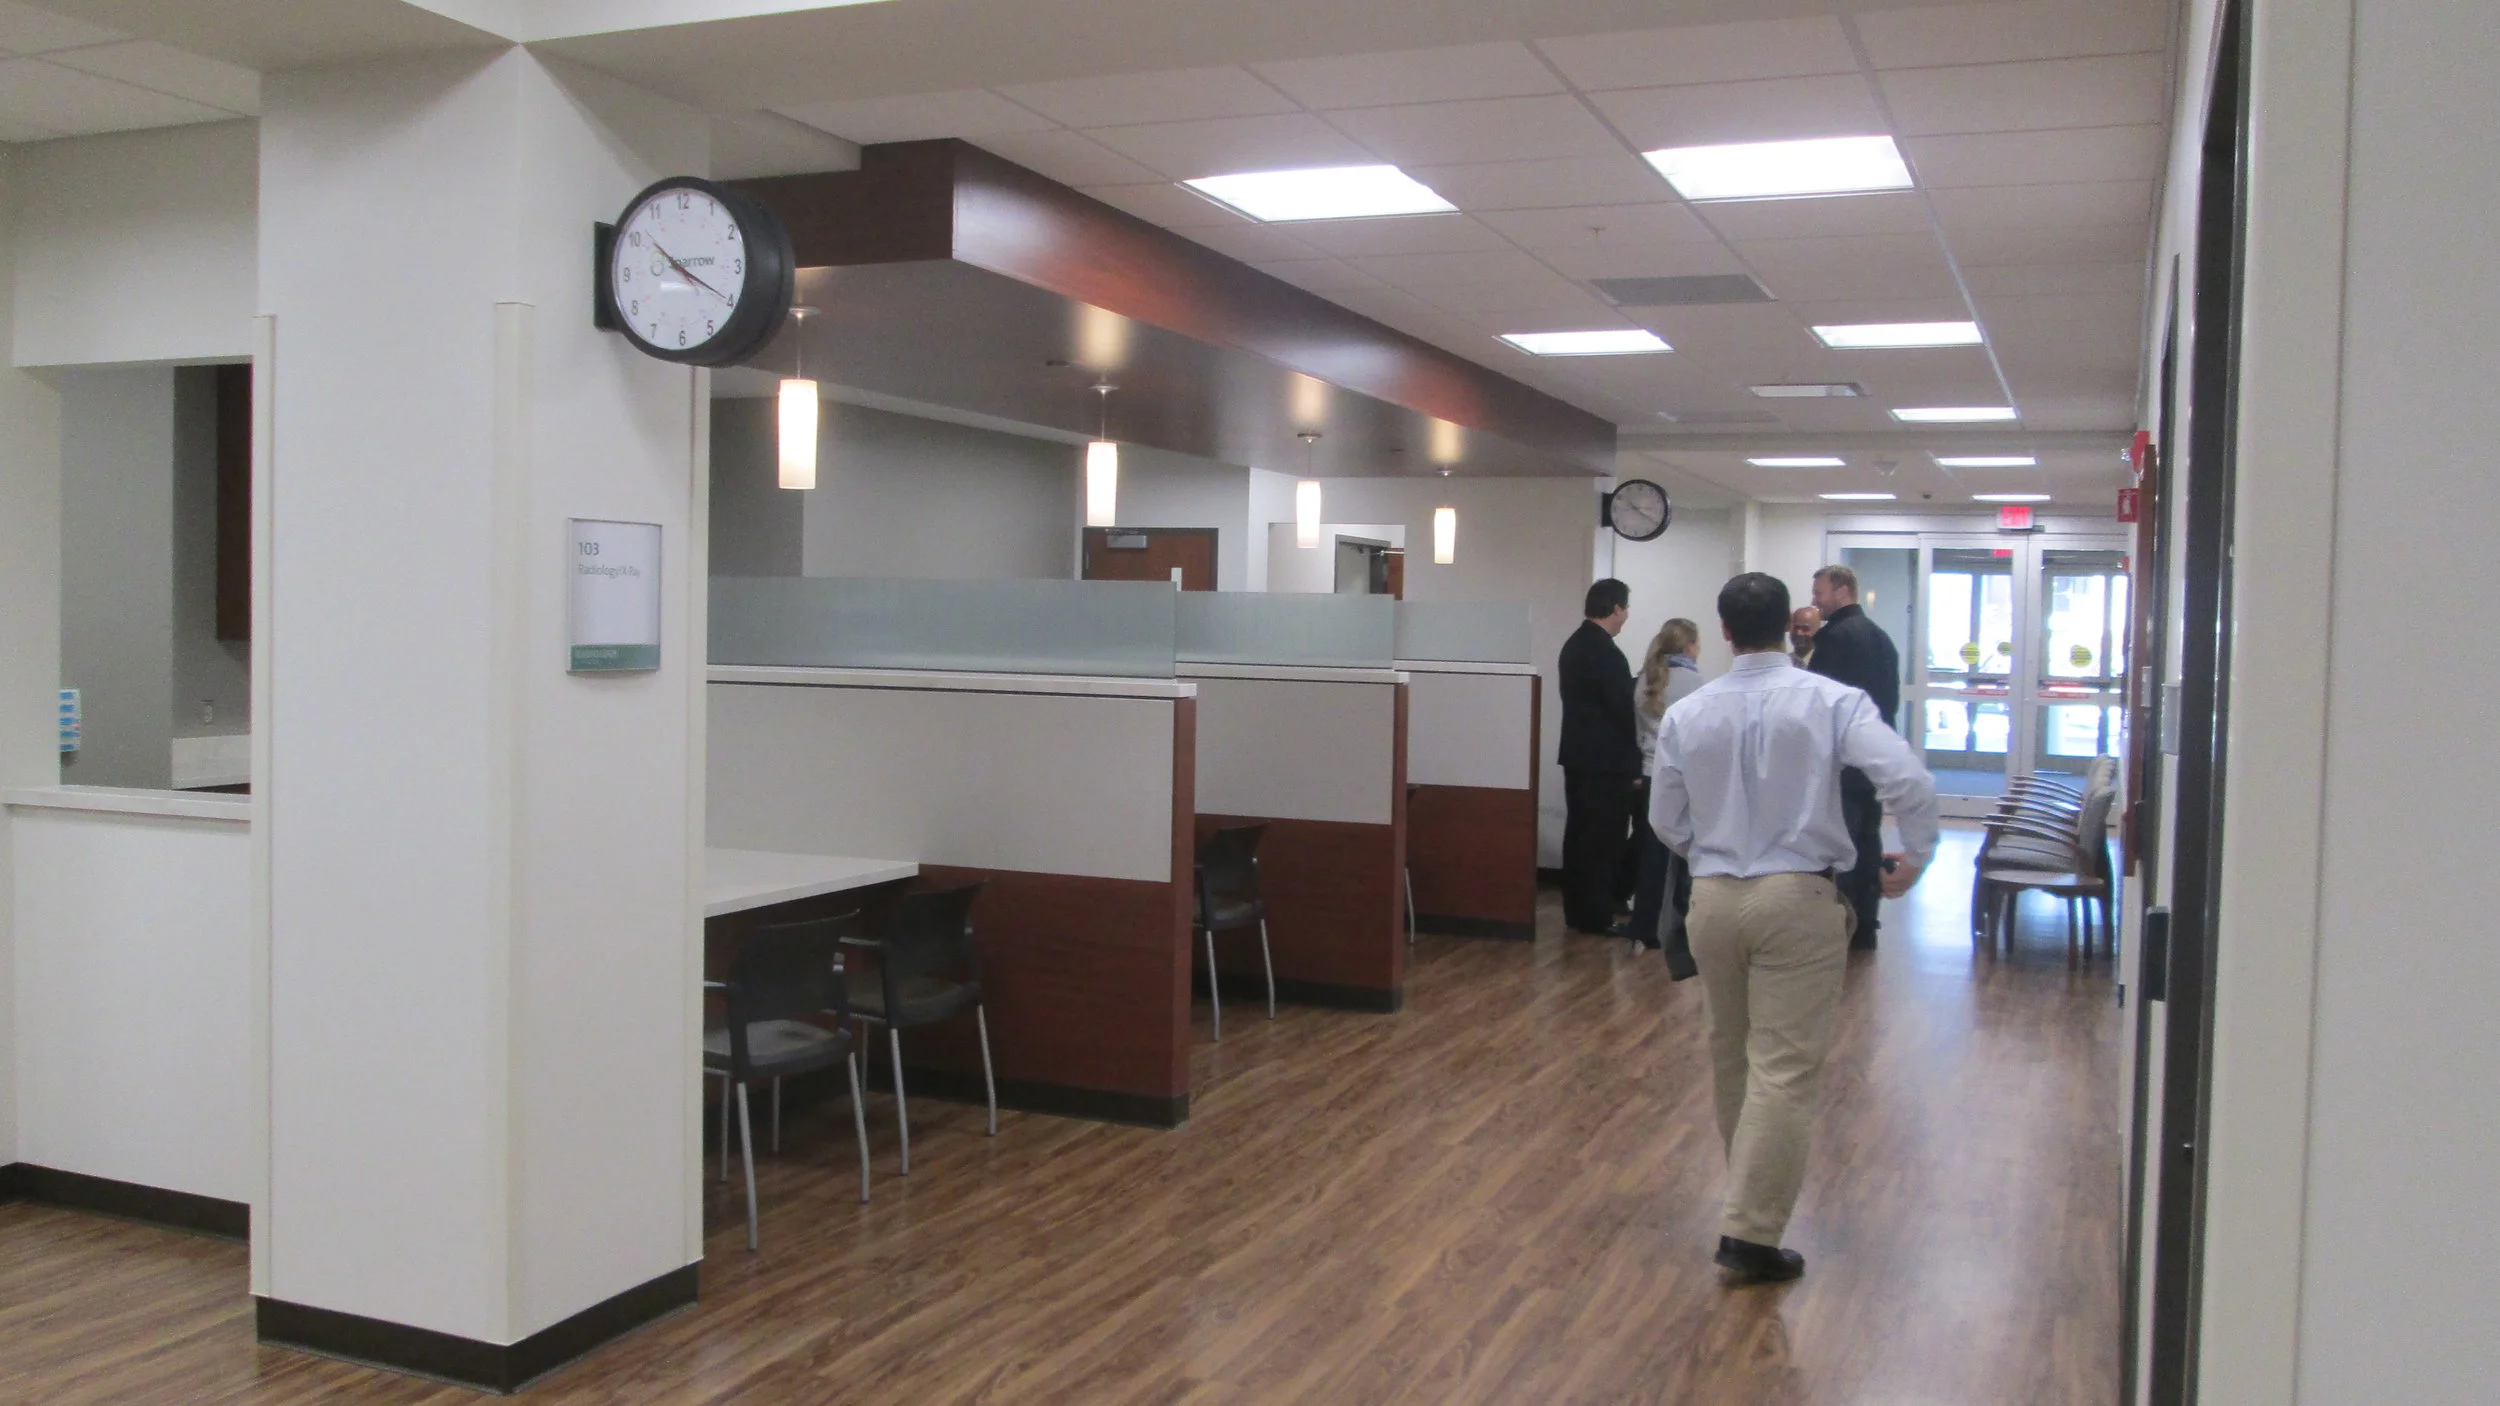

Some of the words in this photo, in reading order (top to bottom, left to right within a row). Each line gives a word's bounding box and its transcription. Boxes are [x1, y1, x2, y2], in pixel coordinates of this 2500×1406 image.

[677, 193, 689, 210] 12
[709, 200, 715, 216] 1
[651, 204, 660, 220] 11
[629, 231, 641, 247] 10
[728, 224, 735, 240] 2
[624, 267, 631, 282] 9
[734, 259, 741, 275] 3
[631, 300, 638, 315] 8
[727, 293, 734, 308] 4
[650, 323, 657, 339] 7
[707, 320, 714, 336] 5
[679, 331, 686, 346] 6
[578, 542, 600, 555] 103
